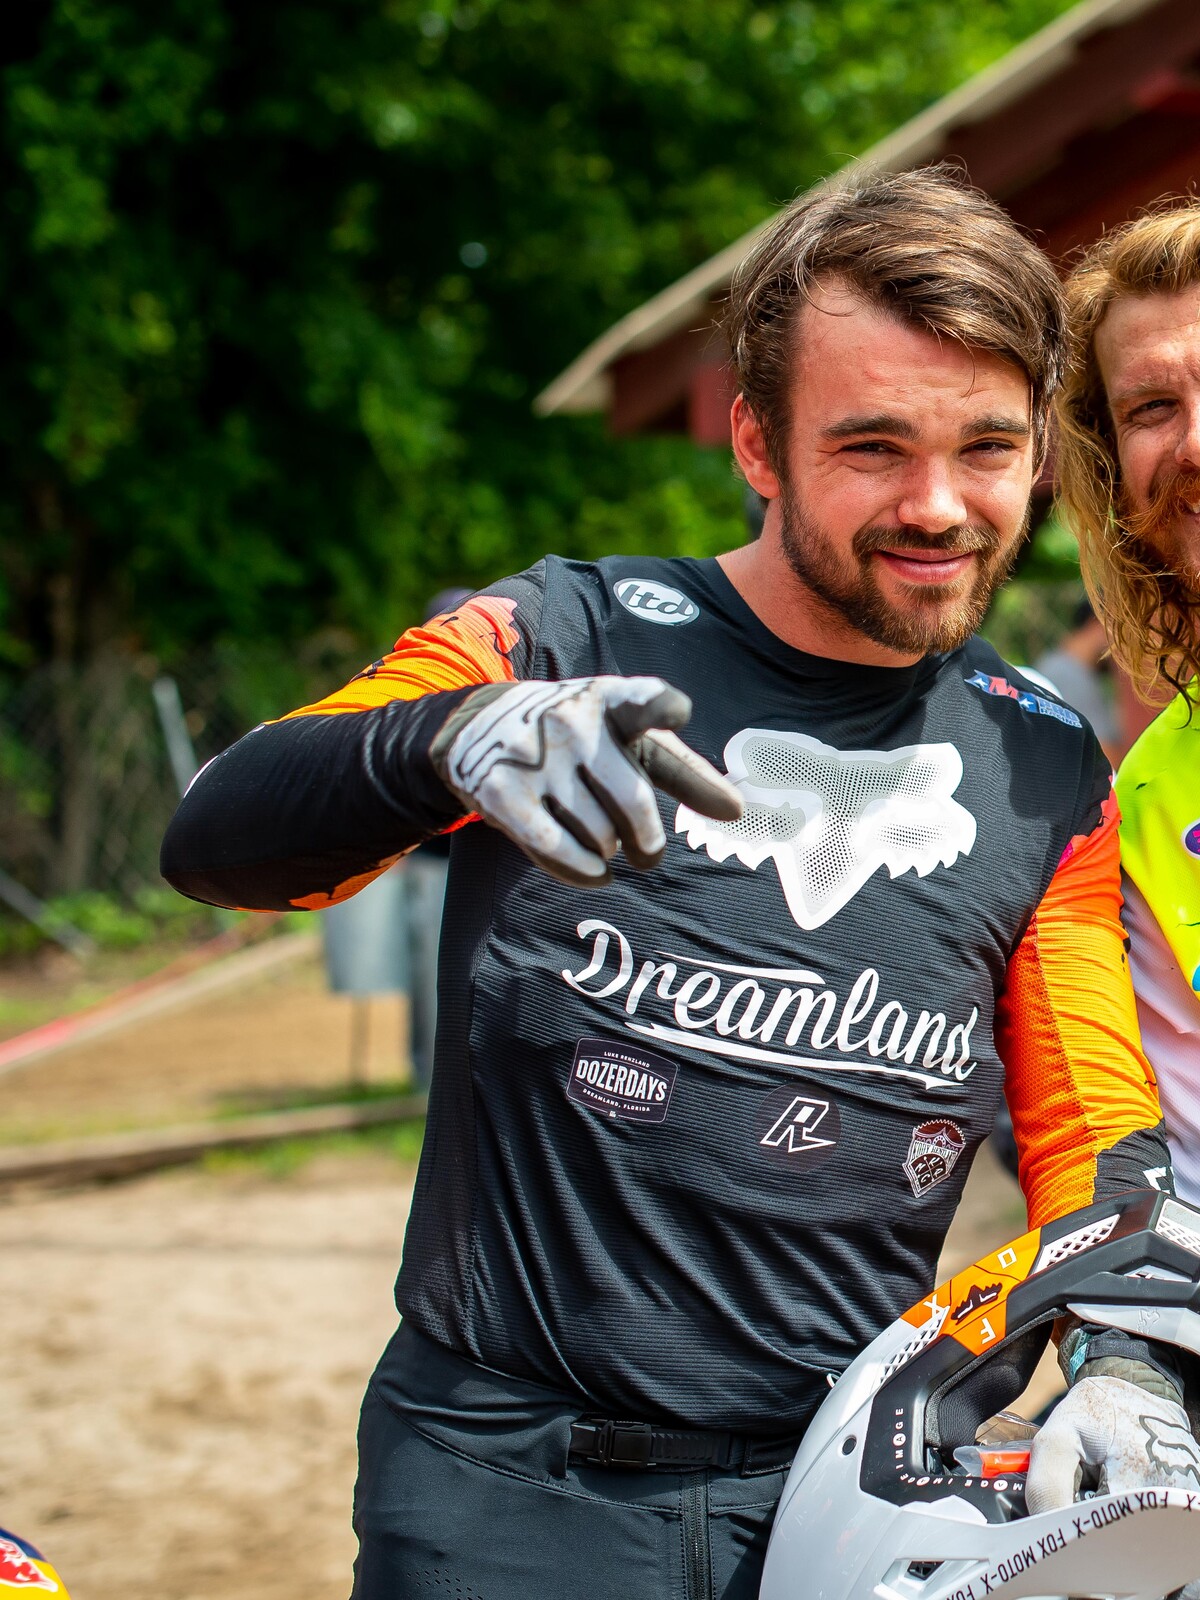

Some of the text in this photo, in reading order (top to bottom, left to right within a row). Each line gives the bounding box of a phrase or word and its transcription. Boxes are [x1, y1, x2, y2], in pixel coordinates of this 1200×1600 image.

[620, 584, 694, 617] ltd
[561, 919, 978, 1081] Dreamland
[603, 1051, 619, 1059] LUKE
[575, 1059, 668, 1102] DOZERDAYS
[582, 1088, 651, 1112] DREAMLAND, FLORIDA
[1134, 1490, 1169, 1509] FOX
[1072, 1498, 1134, 1539] MOTO-X
[1036, 1527, 1068, 1557] FOX
[980, 1545, 1037, 1595] MOTO-X
